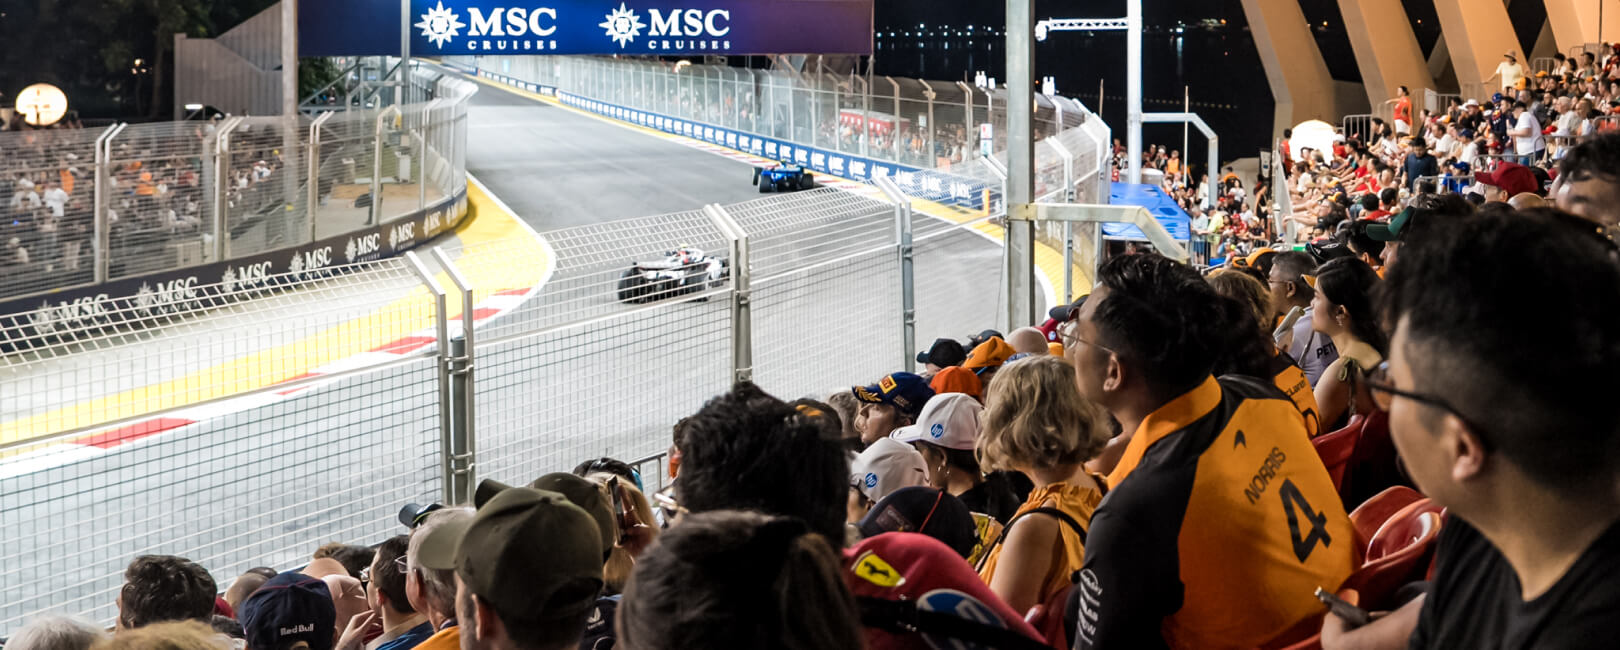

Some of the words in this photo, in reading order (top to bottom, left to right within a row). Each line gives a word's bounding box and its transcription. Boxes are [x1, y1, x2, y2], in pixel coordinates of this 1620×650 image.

[467, 7, 557, 36] MSC
[648, 8, 731, 37] MSC
[467, 40, 557, 50] CRUISES
[648, 40, 731, 50] CRUISES
[397, 221, 416, 242] MSC
[357, 233, 381, 256] MSC
[305, 246, 333, 271] MSC
[239, 261, 272, 286] MSC
[157, 276, 198, 304] MSC
[59, 293, 109, 326] MSC
[1316, 341, 1338, 359] PET
[931, 423, 944, 438] hp
[865, 473, 878, 488] hp
[1244, 446, 1286, 505] NORRIS
[1279, 478, 1332, 564] 4
[280, 625, 298, 636] Red
[298, 623, 314, 633] Bull
